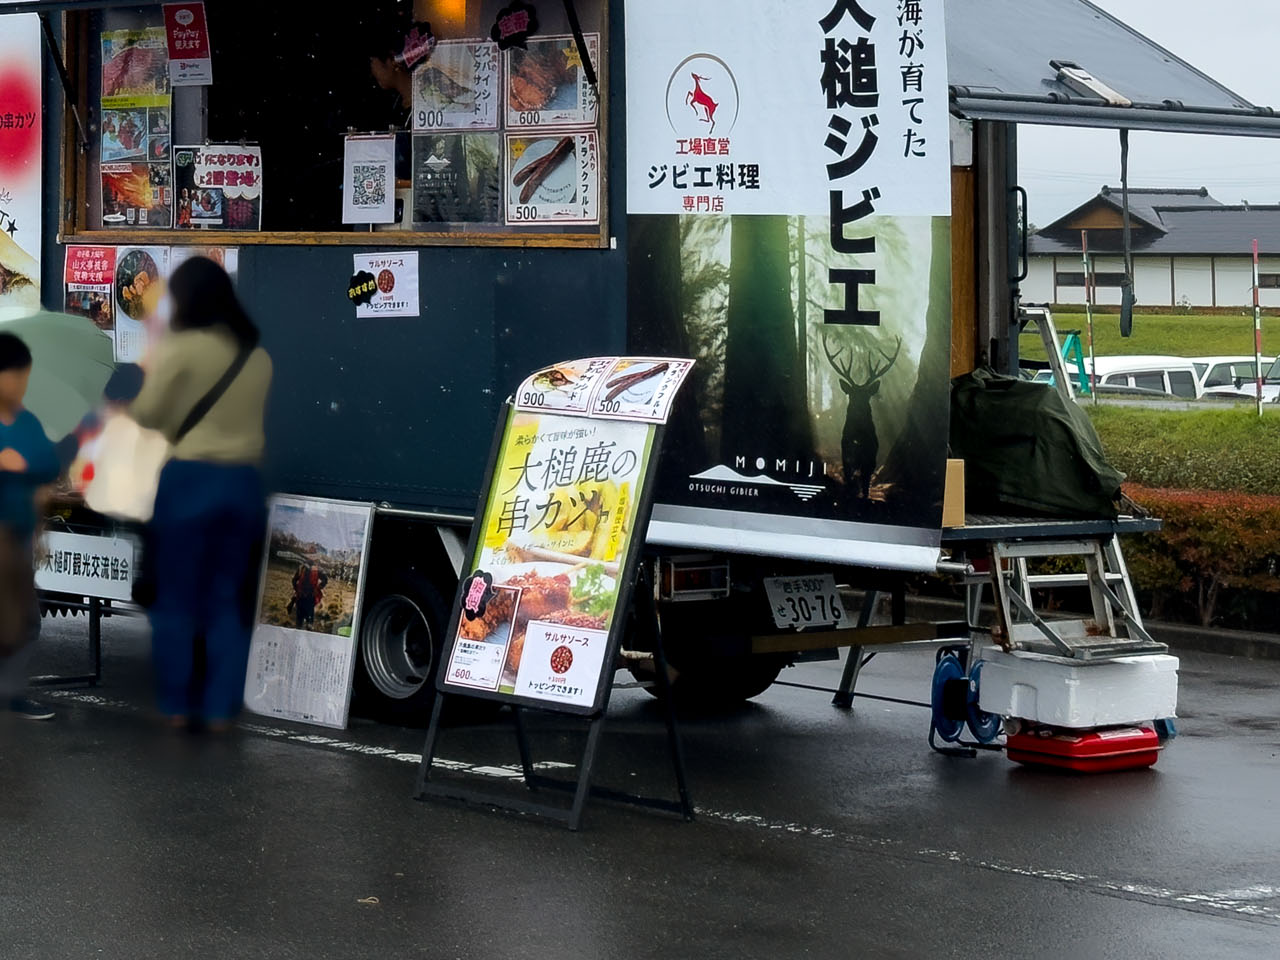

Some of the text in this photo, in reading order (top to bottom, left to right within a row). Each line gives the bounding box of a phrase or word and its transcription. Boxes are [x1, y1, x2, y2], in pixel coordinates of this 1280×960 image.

[418, 110, 444, 127] 900
[519, 111, 540, 125] 600
[675, 138, 730, 156] 工場直営
[580, 135, 589, 218] フランクフルト
[648, 163, 760, 191] ジビエ料理
[515, 205, 537, 219] 500
[682, 195, 724, 213] 専門店
[523, 392, 545, 406] 900
[599, 400, 621, 413] 500
[501, 441, 637, 495] 大槌鹿の
[735, 455, 827, 478] MOMIJI
[688, 483, 759, 497] OTSUCHI GIBIER
[496, 490, 601, 538] 串カツ
[45, 549, 129, 581] 大槌町観光交流協会
[785, 594, 842, 622] 30-76
[544, 631, 589, 647] サルサソース
[455, 669, 471, 680] 600
